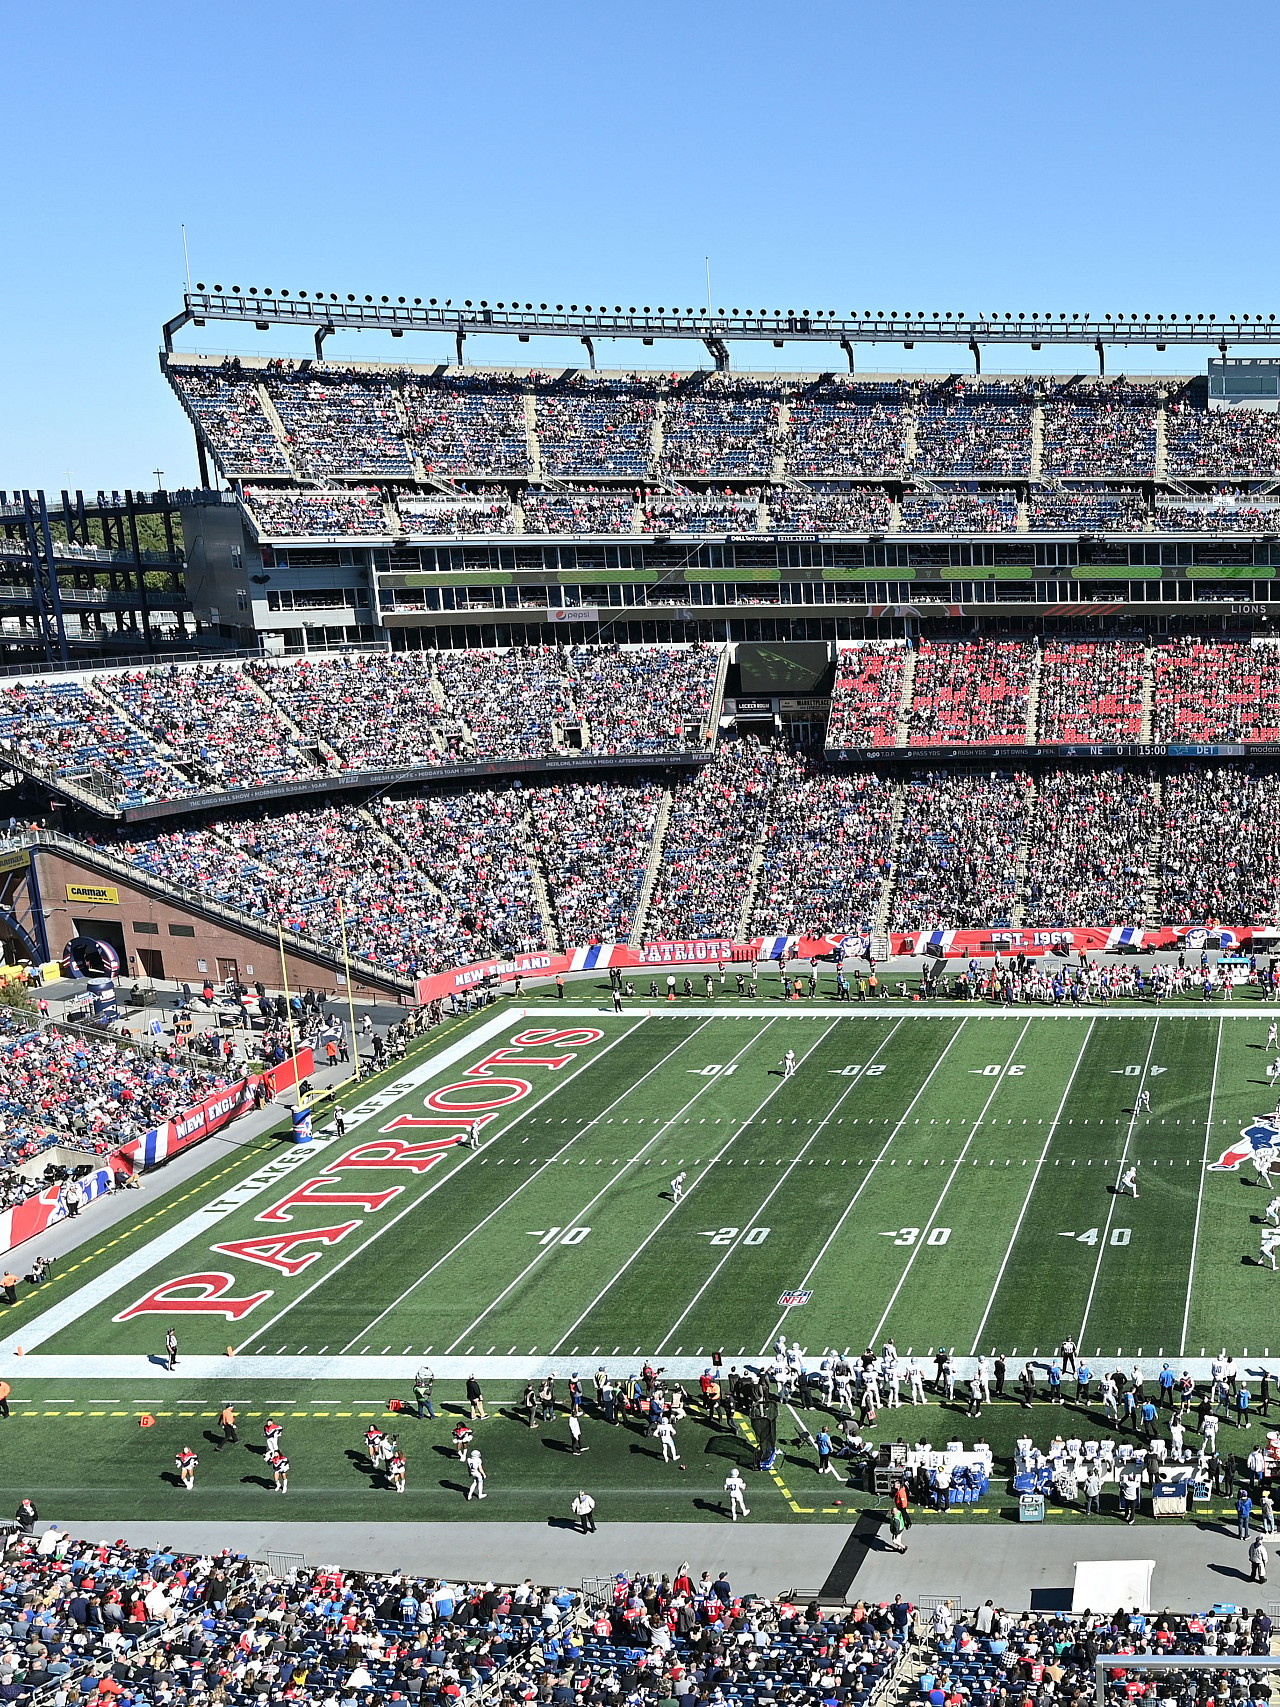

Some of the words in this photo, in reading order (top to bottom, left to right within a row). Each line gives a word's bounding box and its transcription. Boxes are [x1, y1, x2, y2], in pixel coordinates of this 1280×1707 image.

[1232, 605, 1267, 614] LIONS
[567, 611, 590, 621] pepsi
[1090, 747, 1103, 755] NE
[1117, 746, 1123, 755] 0
[1139, 746, 1166, 755] 15:00
[1196, 746, 1215, 755] DET
[232, 793, 250, 801] SHOW
[254, 788, 285, 797] MORNINGS
[991, 932, 1029, 946] EST.
[638, 940, 732, 963] PATRIOTS
[455, 968, 484, 987] NEW
[490, 957, 550, 976] ENGLAND
[841, 1065, 887, 1076] 20
[982, 1065, 1027, 1076] 30
[1125, 1065, 1169, 1076] 40
[176, 1110, 205, 1140] NEW
[204, 1199, 240, 1213] IT
[236, 1148, 316, 1192] TAKES
[353, 1101, 384, 1115] OF
[391, 1083, 414, 1096] US
[112, 1026, 605, 1323] PATRIOTS
[538, 1227, 593, 1246] 10
[708, 1227, 772, 1246] 20
[892, 1228, 953, 1246] 30
[1074, 1228, 1132, 1246] 40
[782, 1295, 807, 1305] NFL
[708, 1607, 716, 1615] 11
